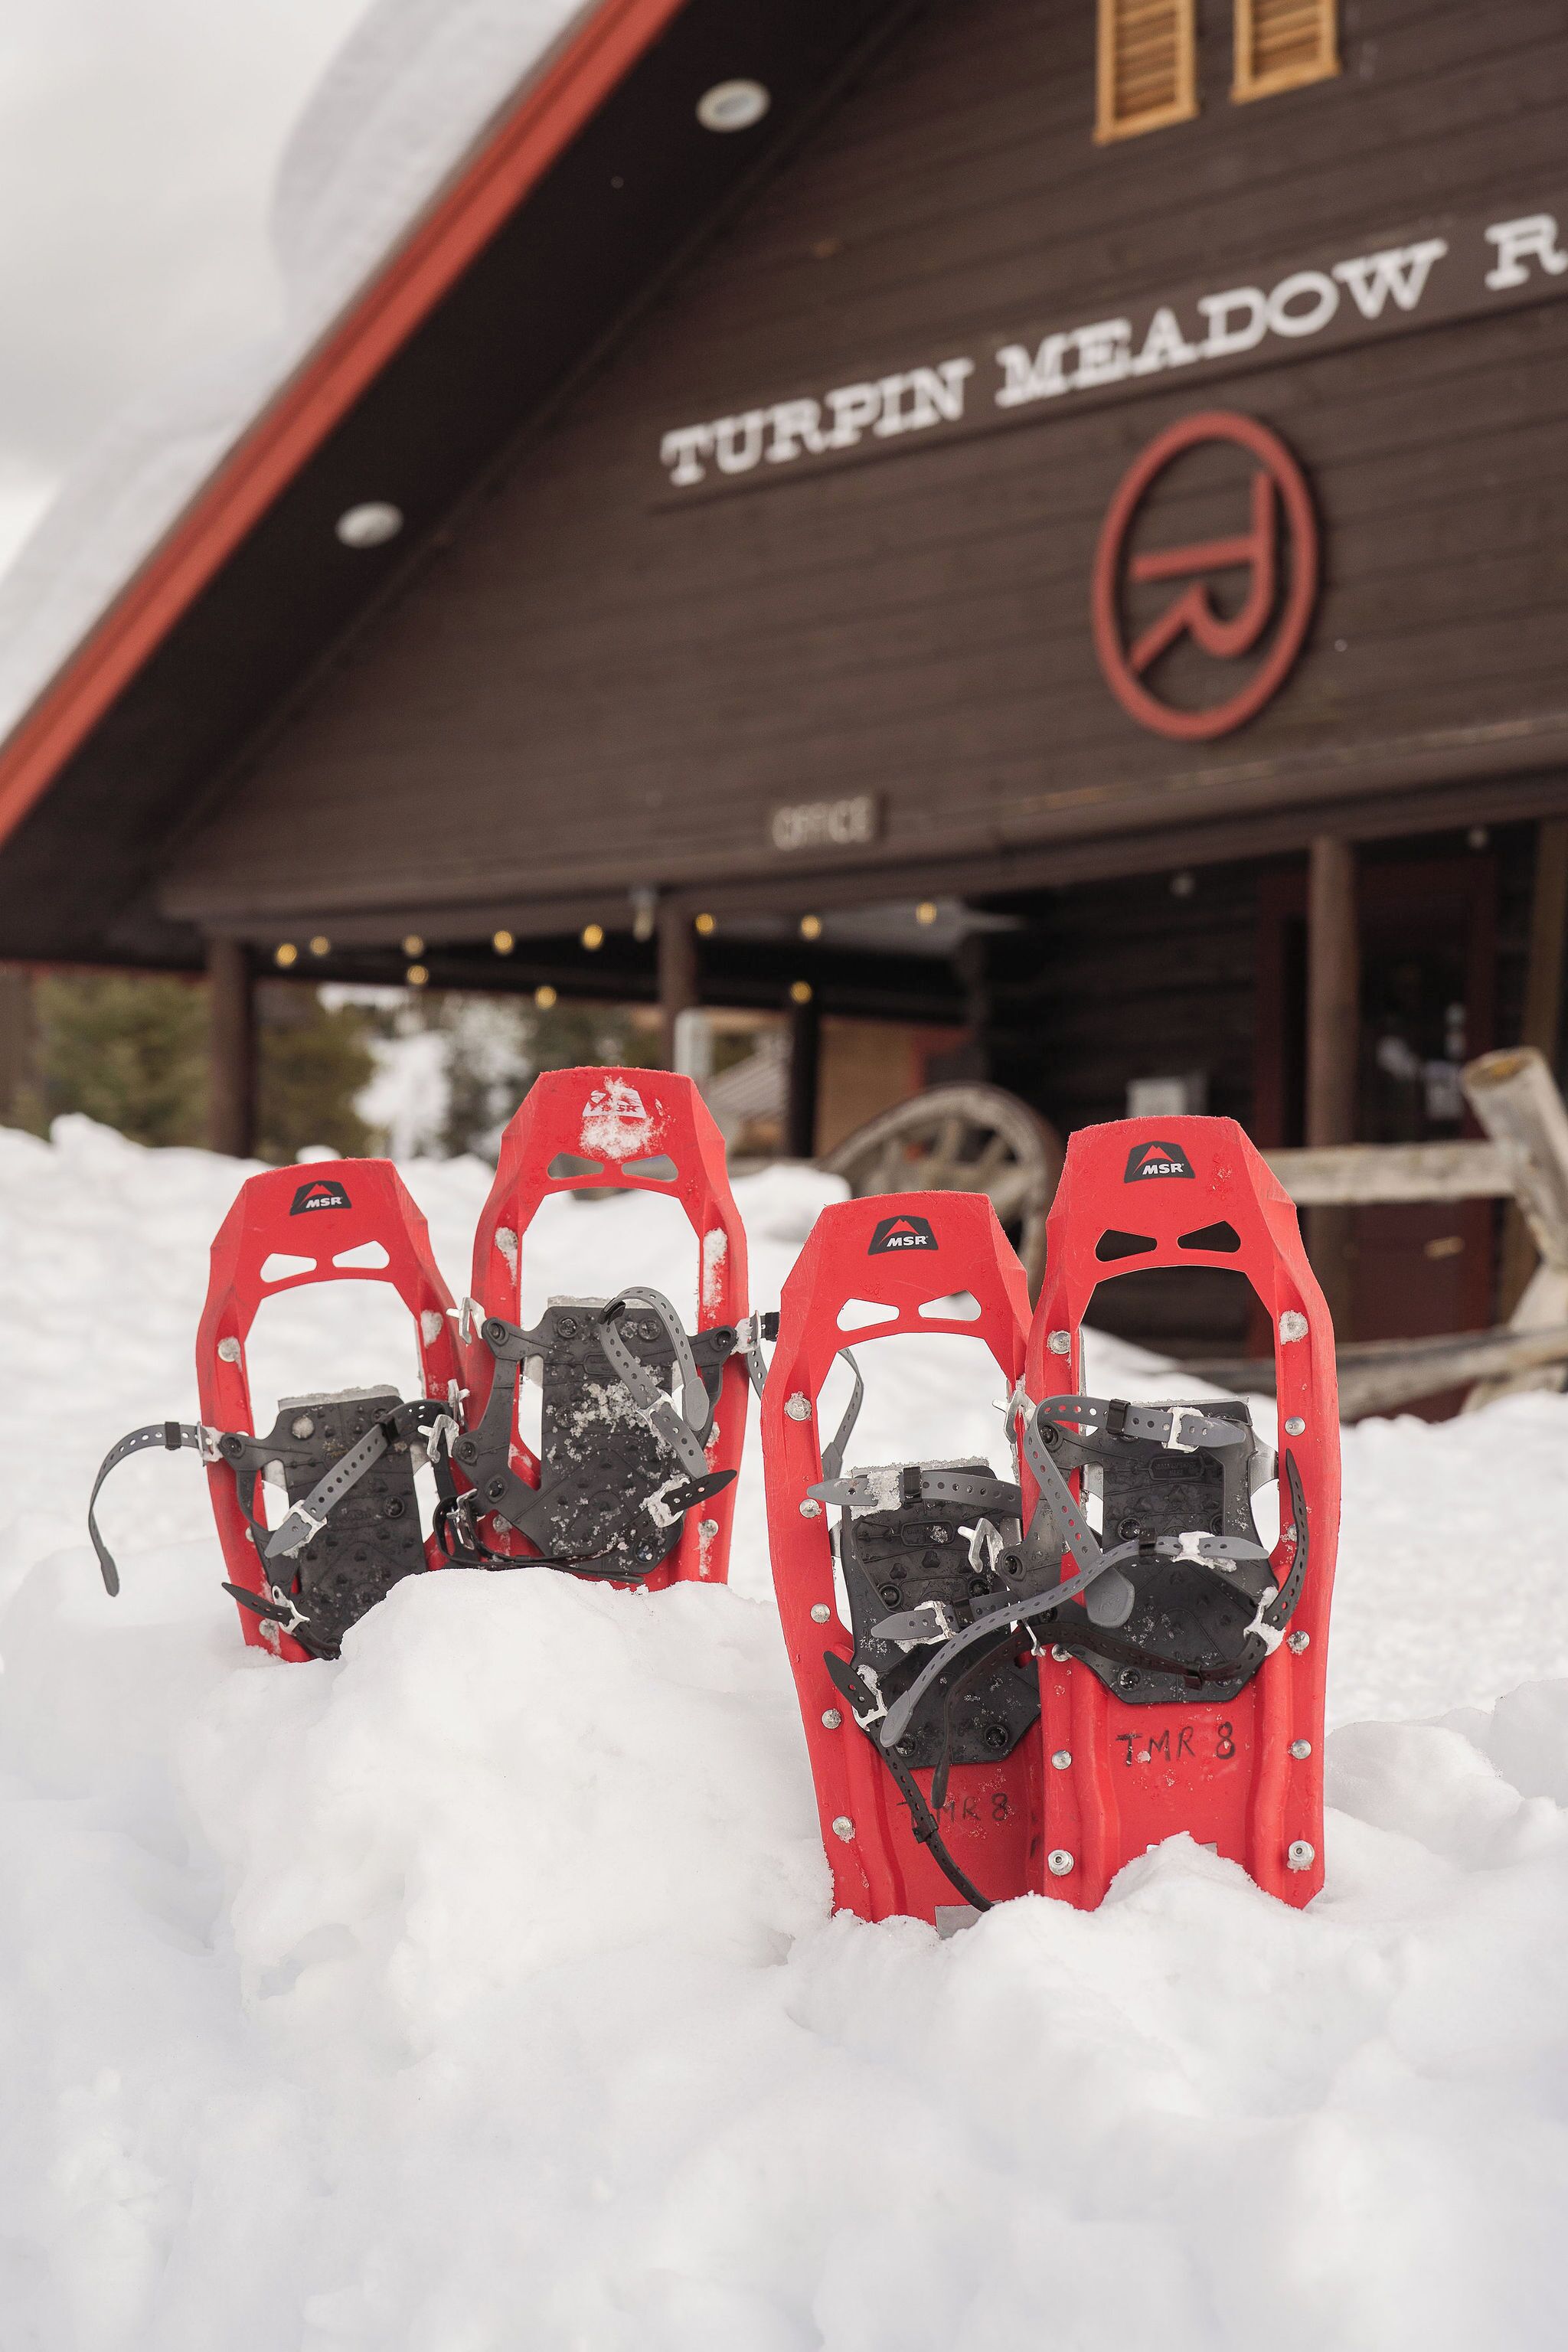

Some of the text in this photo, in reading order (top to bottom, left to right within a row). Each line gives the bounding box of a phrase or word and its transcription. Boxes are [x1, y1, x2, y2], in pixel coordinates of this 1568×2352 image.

[661, 357, 975, 486] TURPIN
[995, 238, 1447, 407] MEADOW
[1142, 1163, 1184, 1174] MSR
[306, 1197, 341, 1208] MSR
[887, 1236, 927, 1247] MSR
[1116, 1721, 1236, 1766] TMR 8
[991, 1792, 1009, 1821] 8
